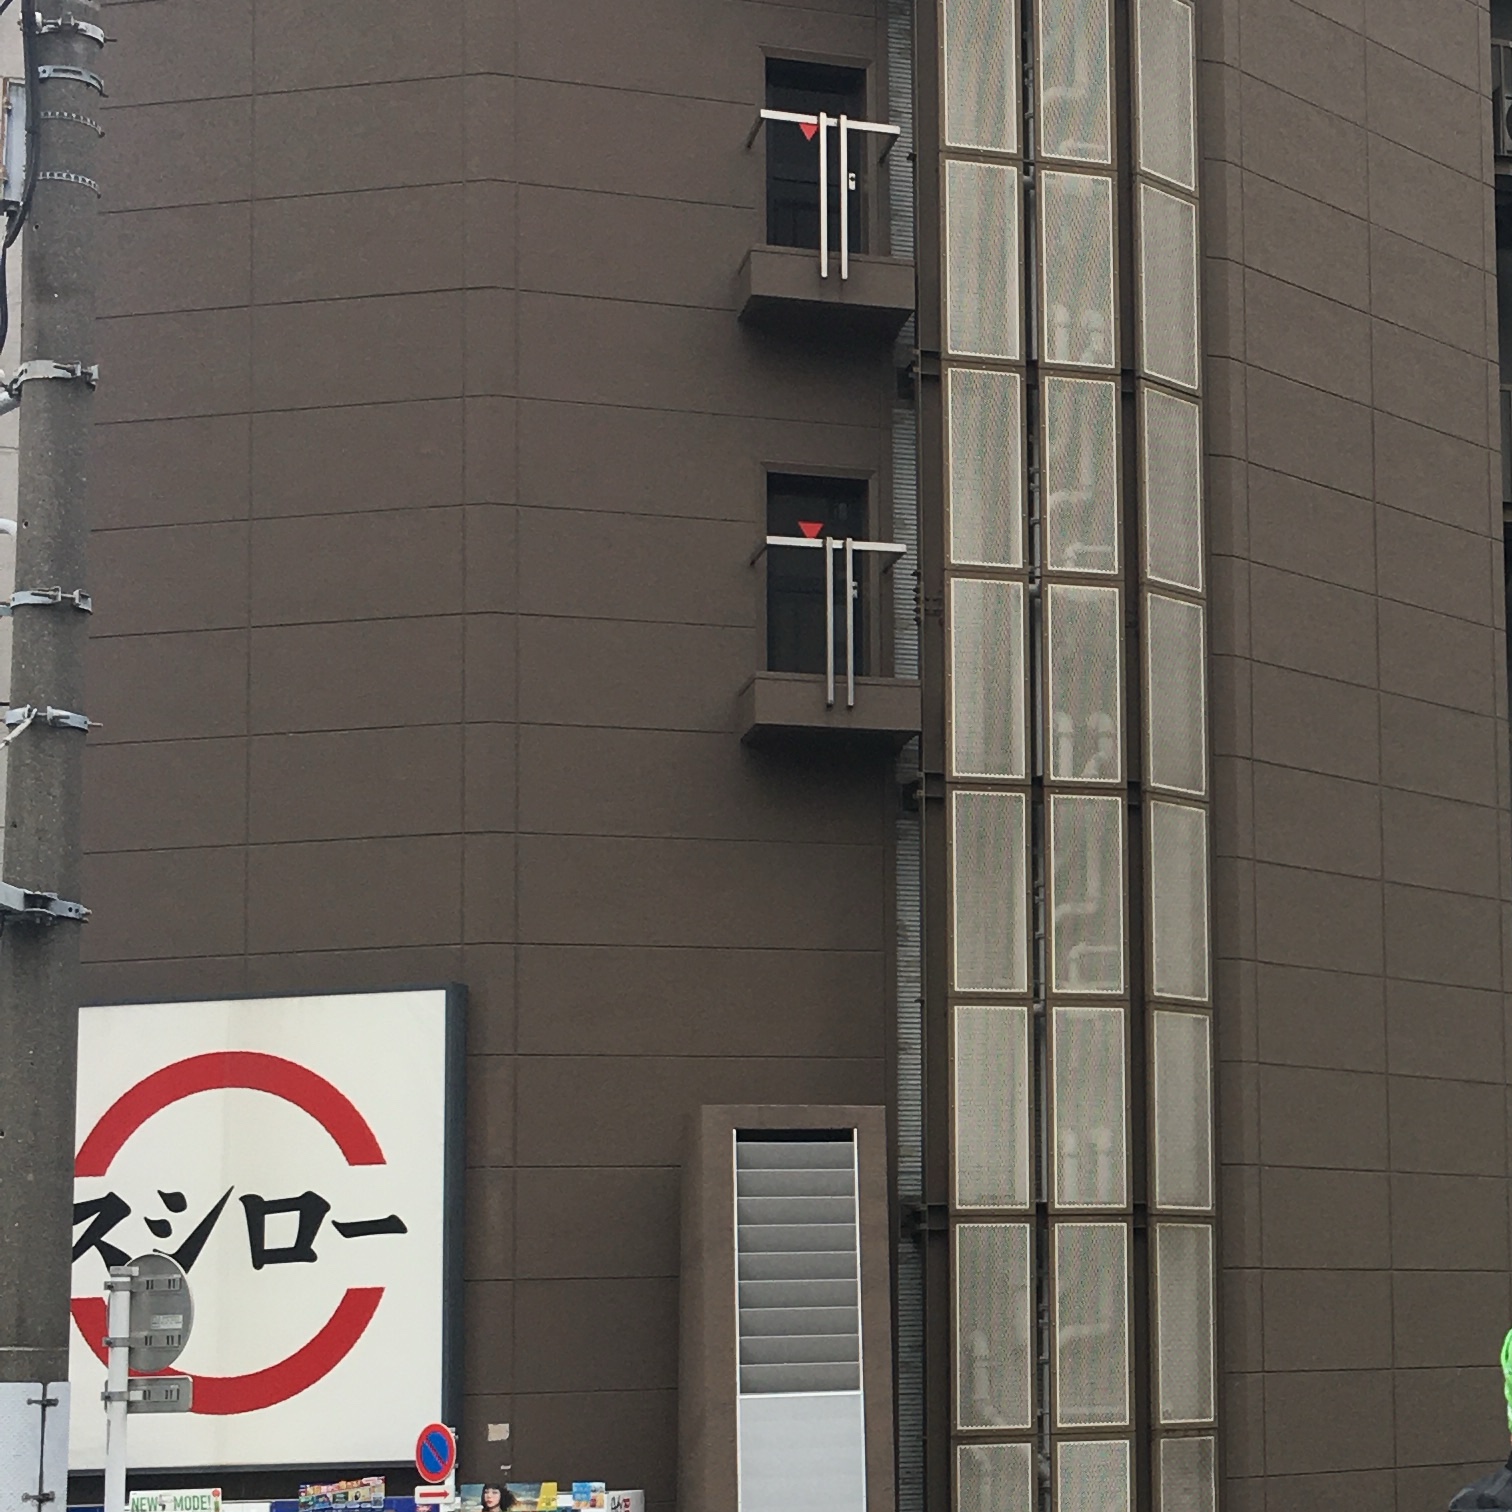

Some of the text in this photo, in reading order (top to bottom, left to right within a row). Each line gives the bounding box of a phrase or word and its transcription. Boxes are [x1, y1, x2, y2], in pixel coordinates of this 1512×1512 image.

[72, 1185, 408, 1273] スシロー
[131, 1494, 212, 1512] NEW MODE!
